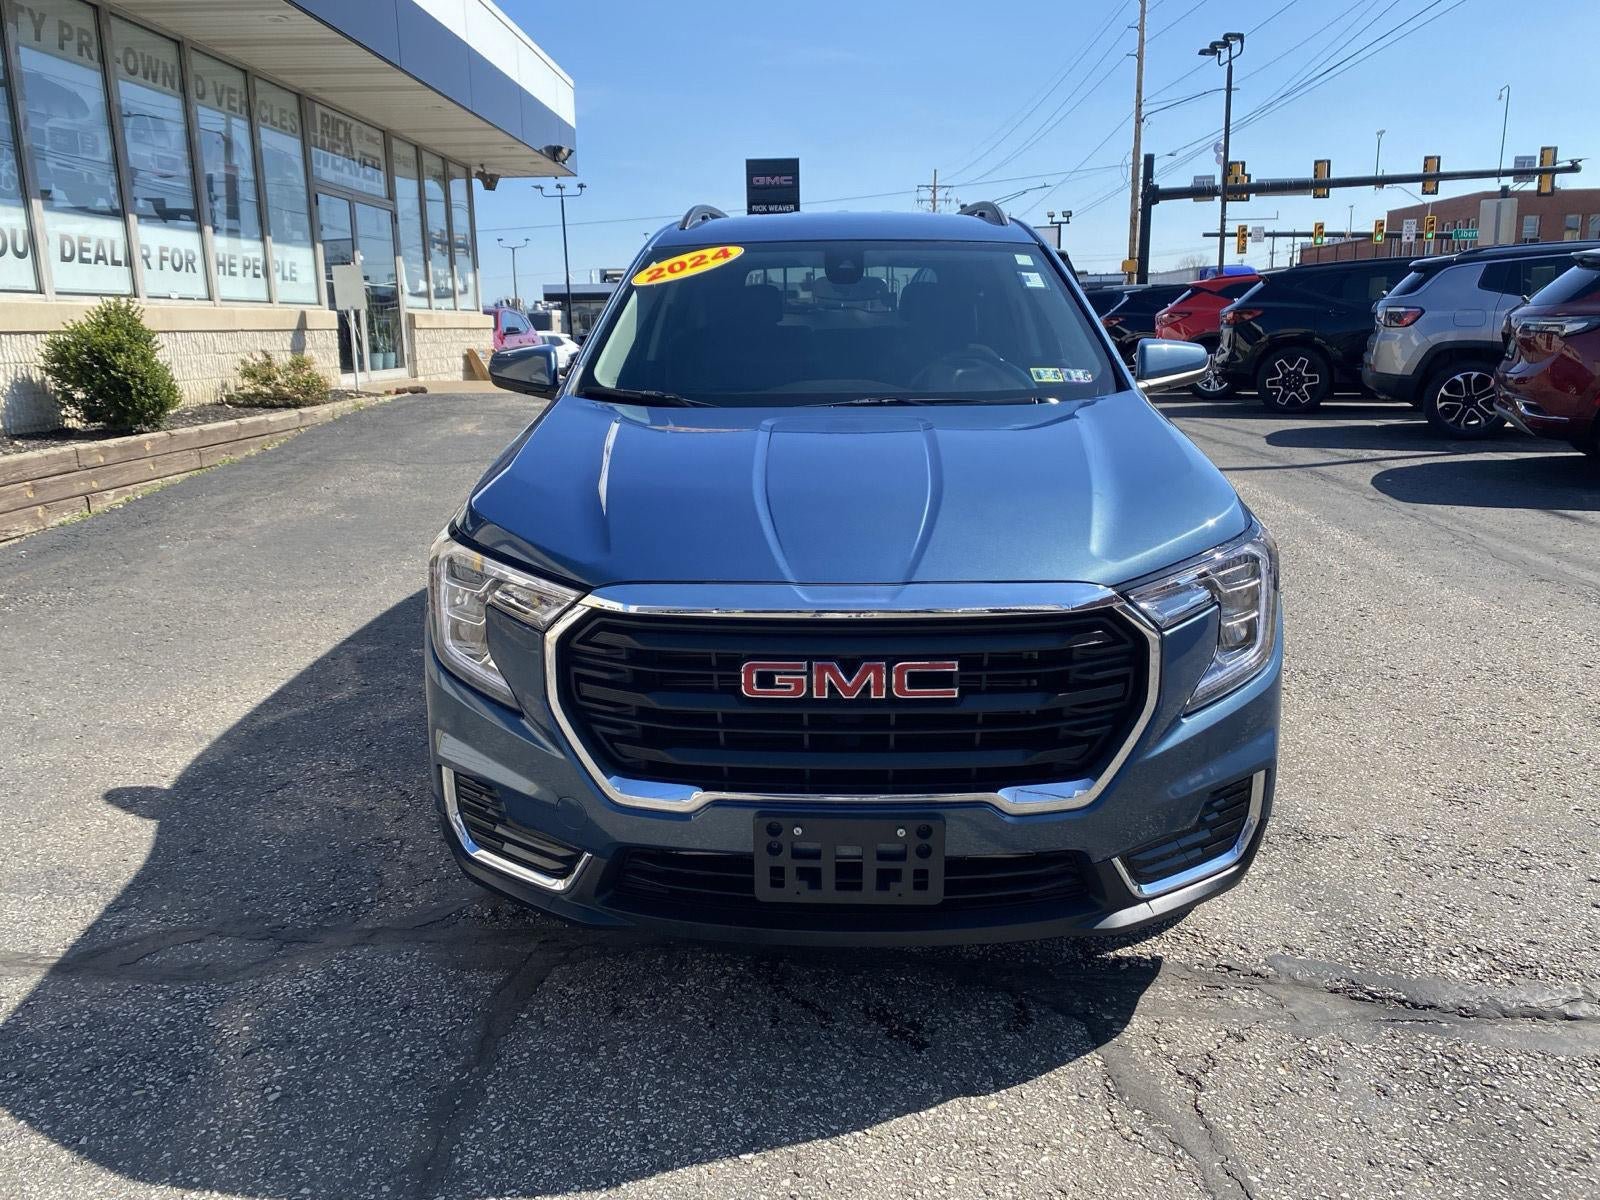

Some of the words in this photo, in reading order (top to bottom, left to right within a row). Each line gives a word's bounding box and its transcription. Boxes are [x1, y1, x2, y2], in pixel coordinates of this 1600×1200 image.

[213, 80, 299, 134] VEHCLES
[752, 175, 793, 185] GMC
[751, 204, 768, 212] RICK
[768, 204, 795, 212] WEAVER
[158, 245, 197, 274] FOR
[216, 252, 237, 277] HE
[645, 247, 732, 283] 2024
[741, 660, 959, 699] GMC
